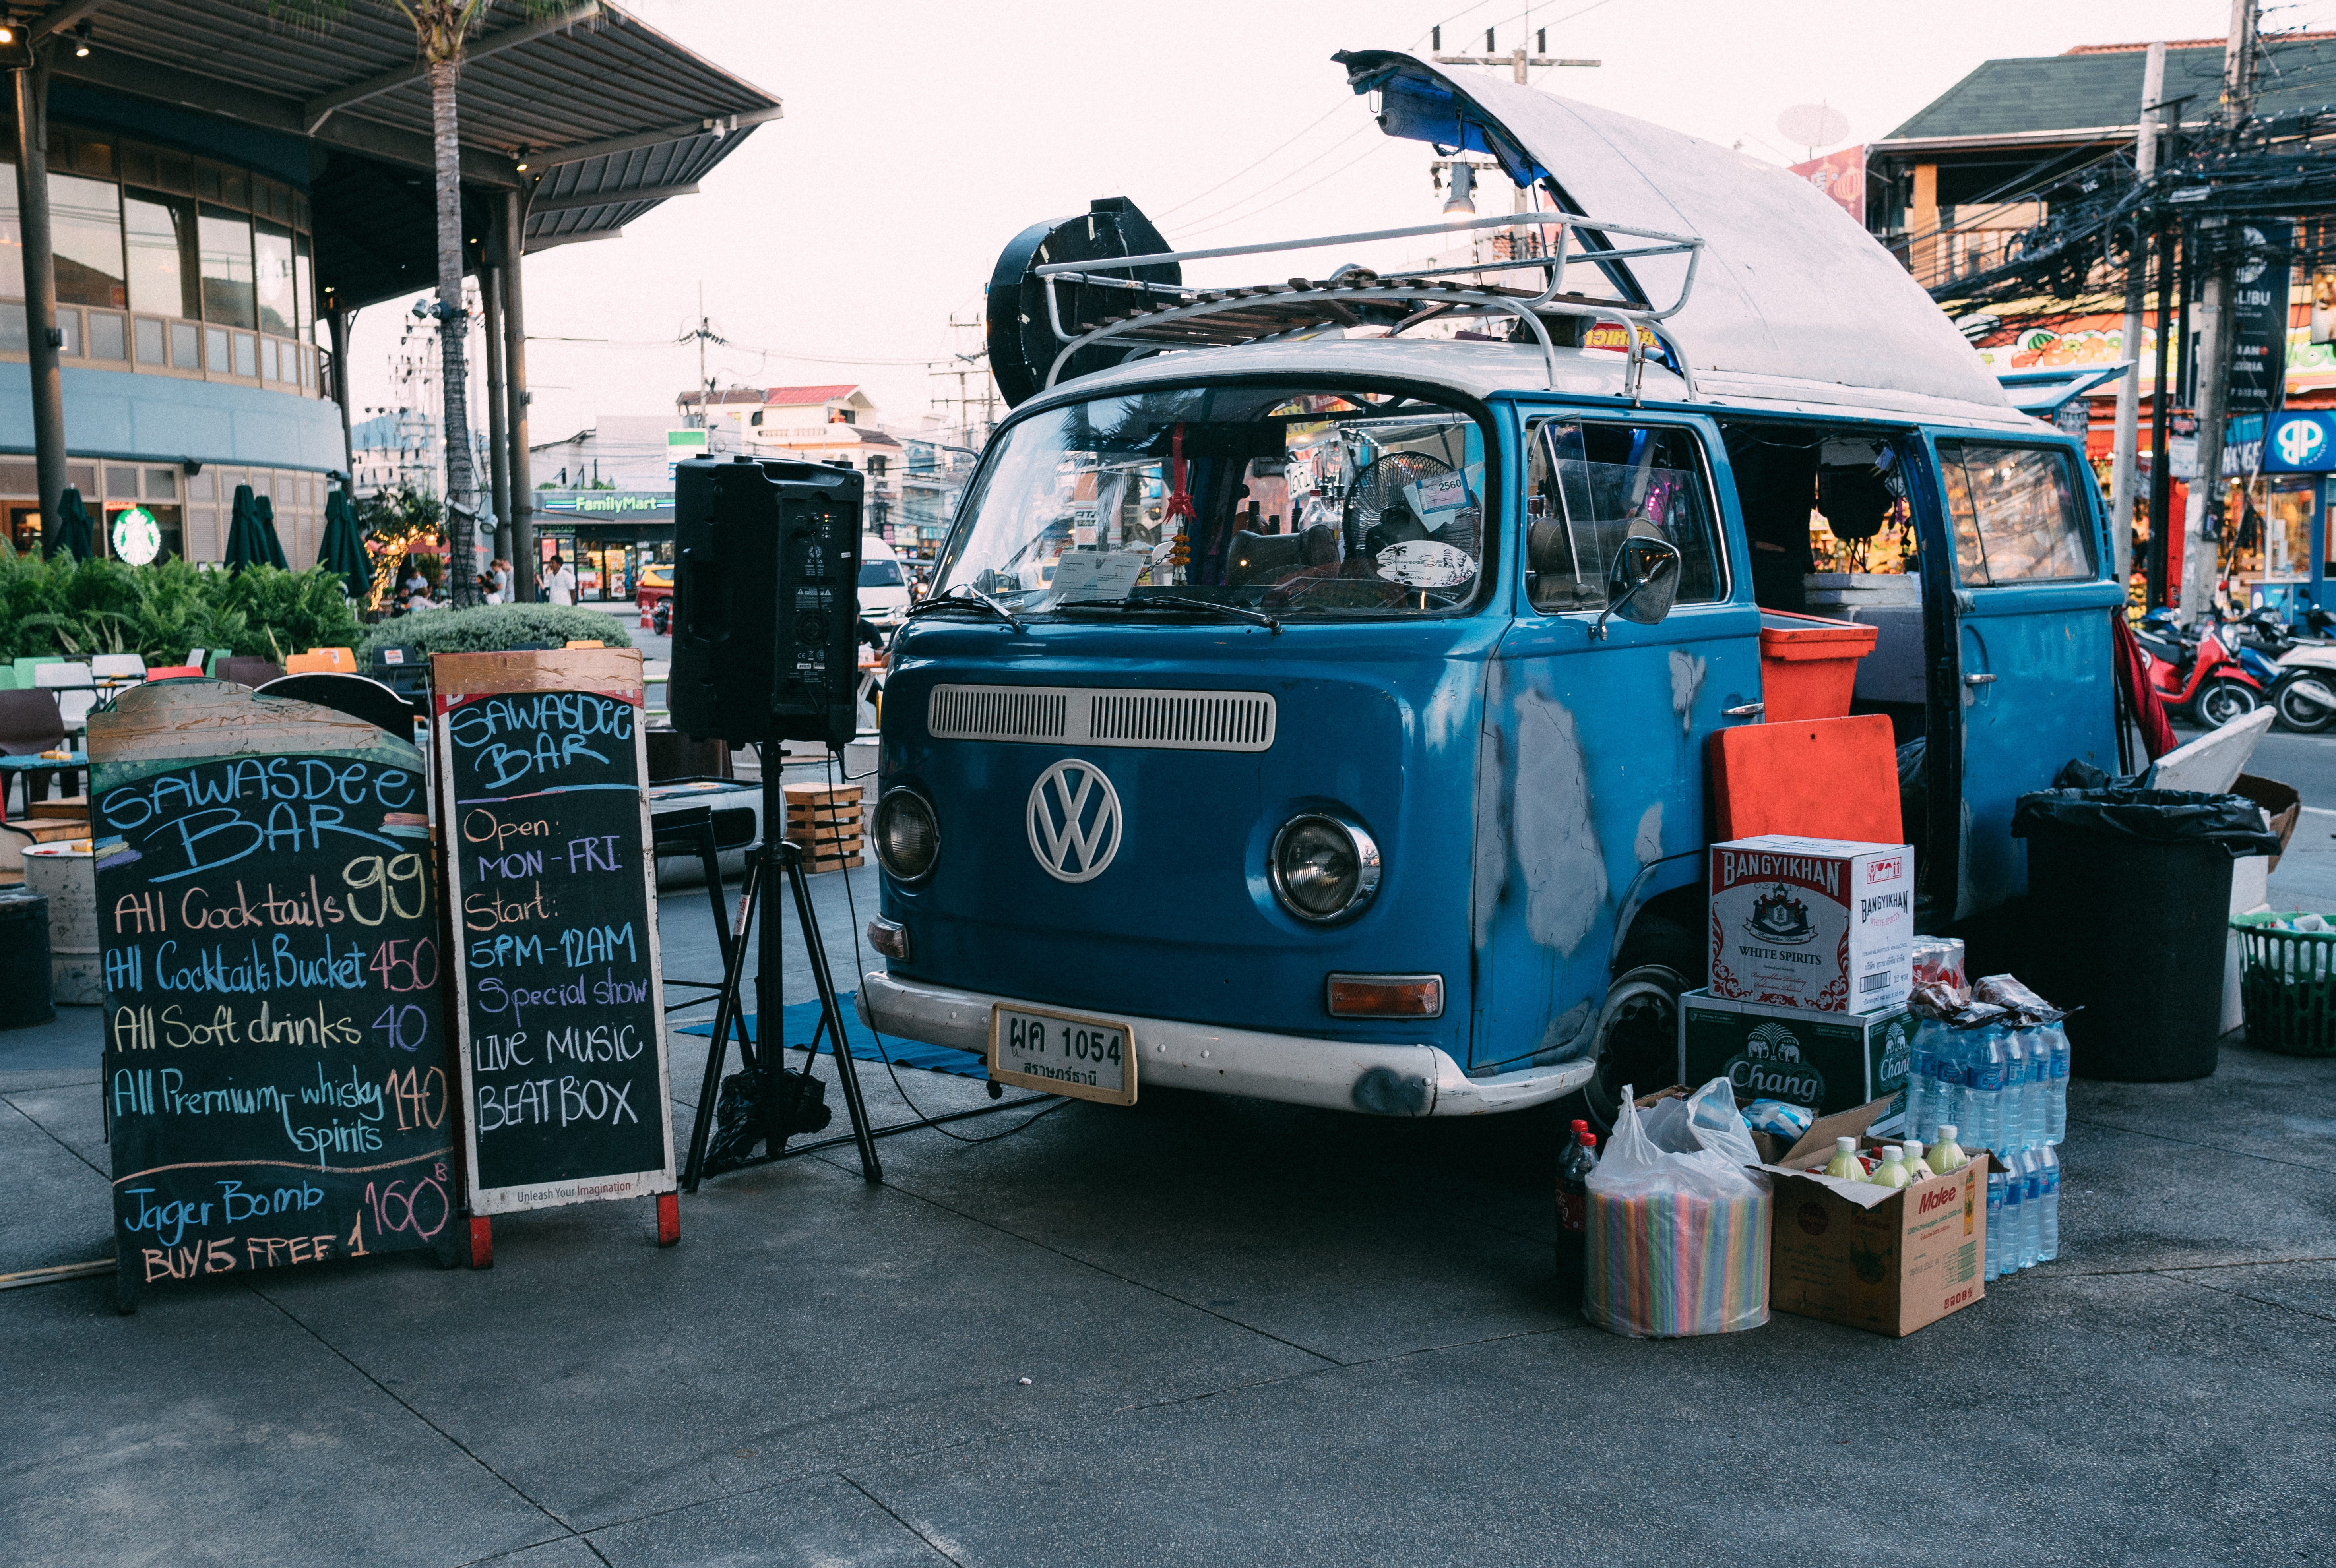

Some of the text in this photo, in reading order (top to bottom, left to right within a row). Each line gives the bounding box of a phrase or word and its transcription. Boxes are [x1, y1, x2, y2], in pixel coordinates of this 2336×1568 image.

[576, 496, 656, 514] FamilyMart
[1439, 479, 1462, 491] 2560
[475, 732, 610, 789] BAR
[144, 802, 405, 883] BAR
[1721, 851, 1843, 897] BANGYIKHAN
[115, 893, 165, 934] All
[1861, 890, 1909, 924] BANGYIKHAN
[1870, 912, 1900, 926] WHITE SPIRITS
[106, 944, 143, 992] All
[272, 934, 366, 989] Bucket
[370, 937, 440, 992] 450
[1739, 946, 1822, 965] WHITE SPIRITS
[479, 967, 647, 1027] Special show
[114, 1000, 426, 1052] All Soft drinks 40
[1062, 1026, 1121, 1066] 1054
[114, 1062, 447, 1131] All Premium whisky 140
[1729, 1061, 1819, 1103] Chang
[297, 1119, 382, 1172] spirits
[124, 1189, 213, 1247] Jager
[215, 1181, 325, 1224] Bomb
[518, 1182, 632, 1204] Unleash Your Imagination
[1919, 1187, 1956, 1214] Malee
